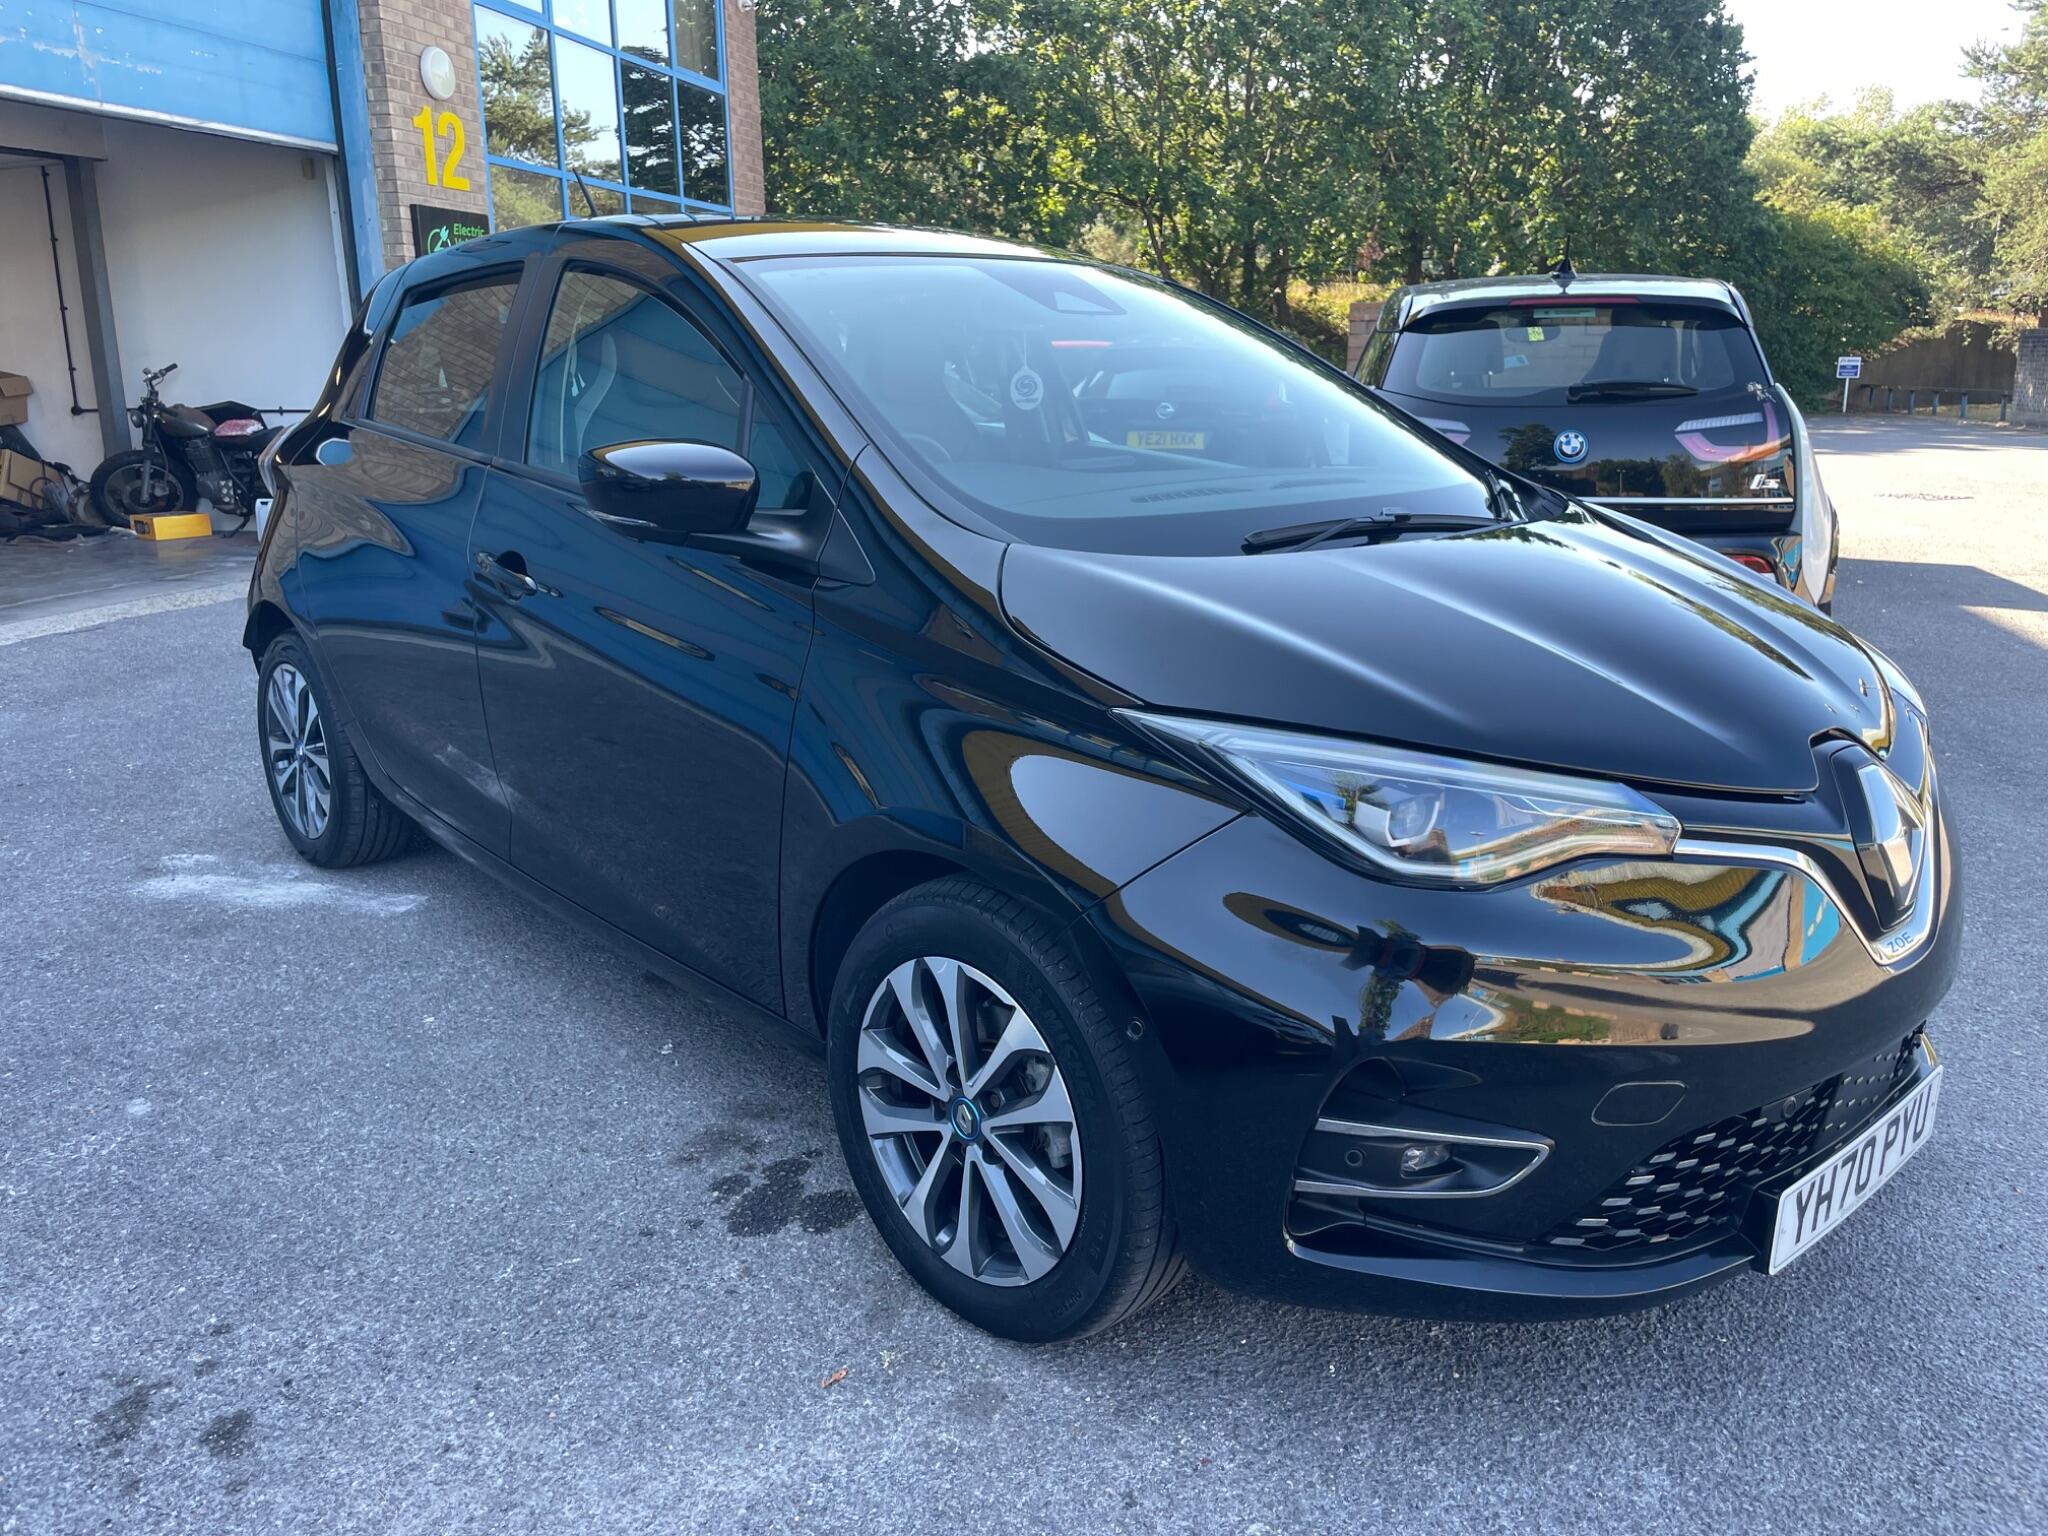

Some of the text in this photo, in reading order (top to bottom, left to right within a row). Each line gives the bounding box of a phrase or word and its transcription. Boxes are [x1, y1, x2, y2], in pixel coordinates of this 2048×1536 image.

[412, 105, 470, 191] 12
[453, 223, 485, 237] Electric
[1887, 932, 1914, 953] ZOE
[1795, 1084, 1932, 1245] YH70 PYU
